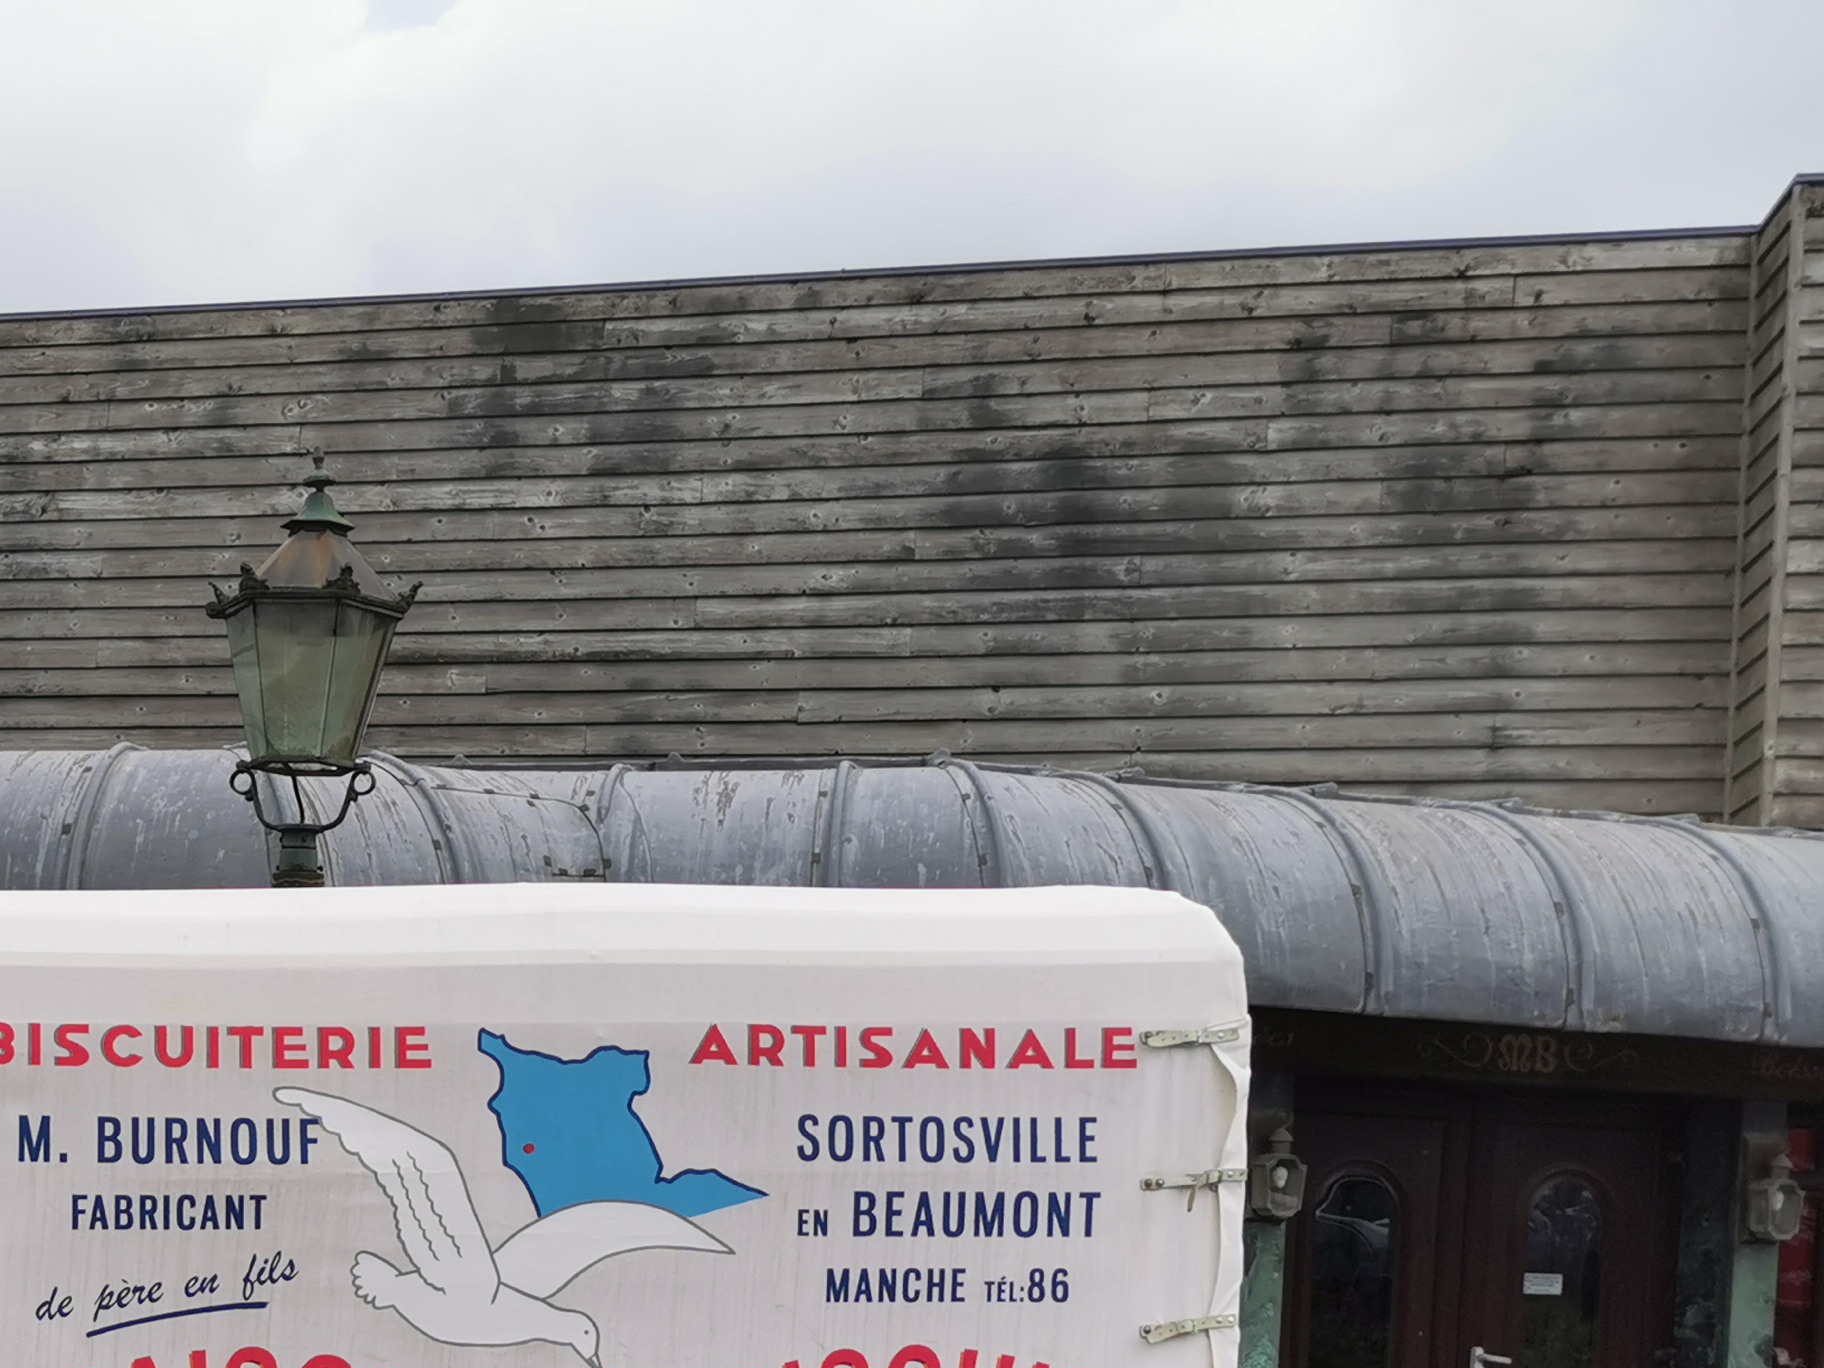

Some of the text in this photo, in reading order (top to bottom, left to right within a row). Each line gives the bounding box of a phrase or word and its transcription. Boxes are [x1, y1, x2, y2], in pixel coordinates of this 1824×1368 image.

[689, 1023, 1138, 1069] ARTISANALE
[18, 1115, 321, 1165] M. BURNOUF
[796, 1114, 1099, 1164] SORTOSVILLE
[72, 1194, 267, 1231] FABRICANT
[797, 1192, 1102, 1238] EN BEAUMONT
[35, 1250, 299, 1323] de père en fils
[826, 1268, 967, 1303] MANCHE
